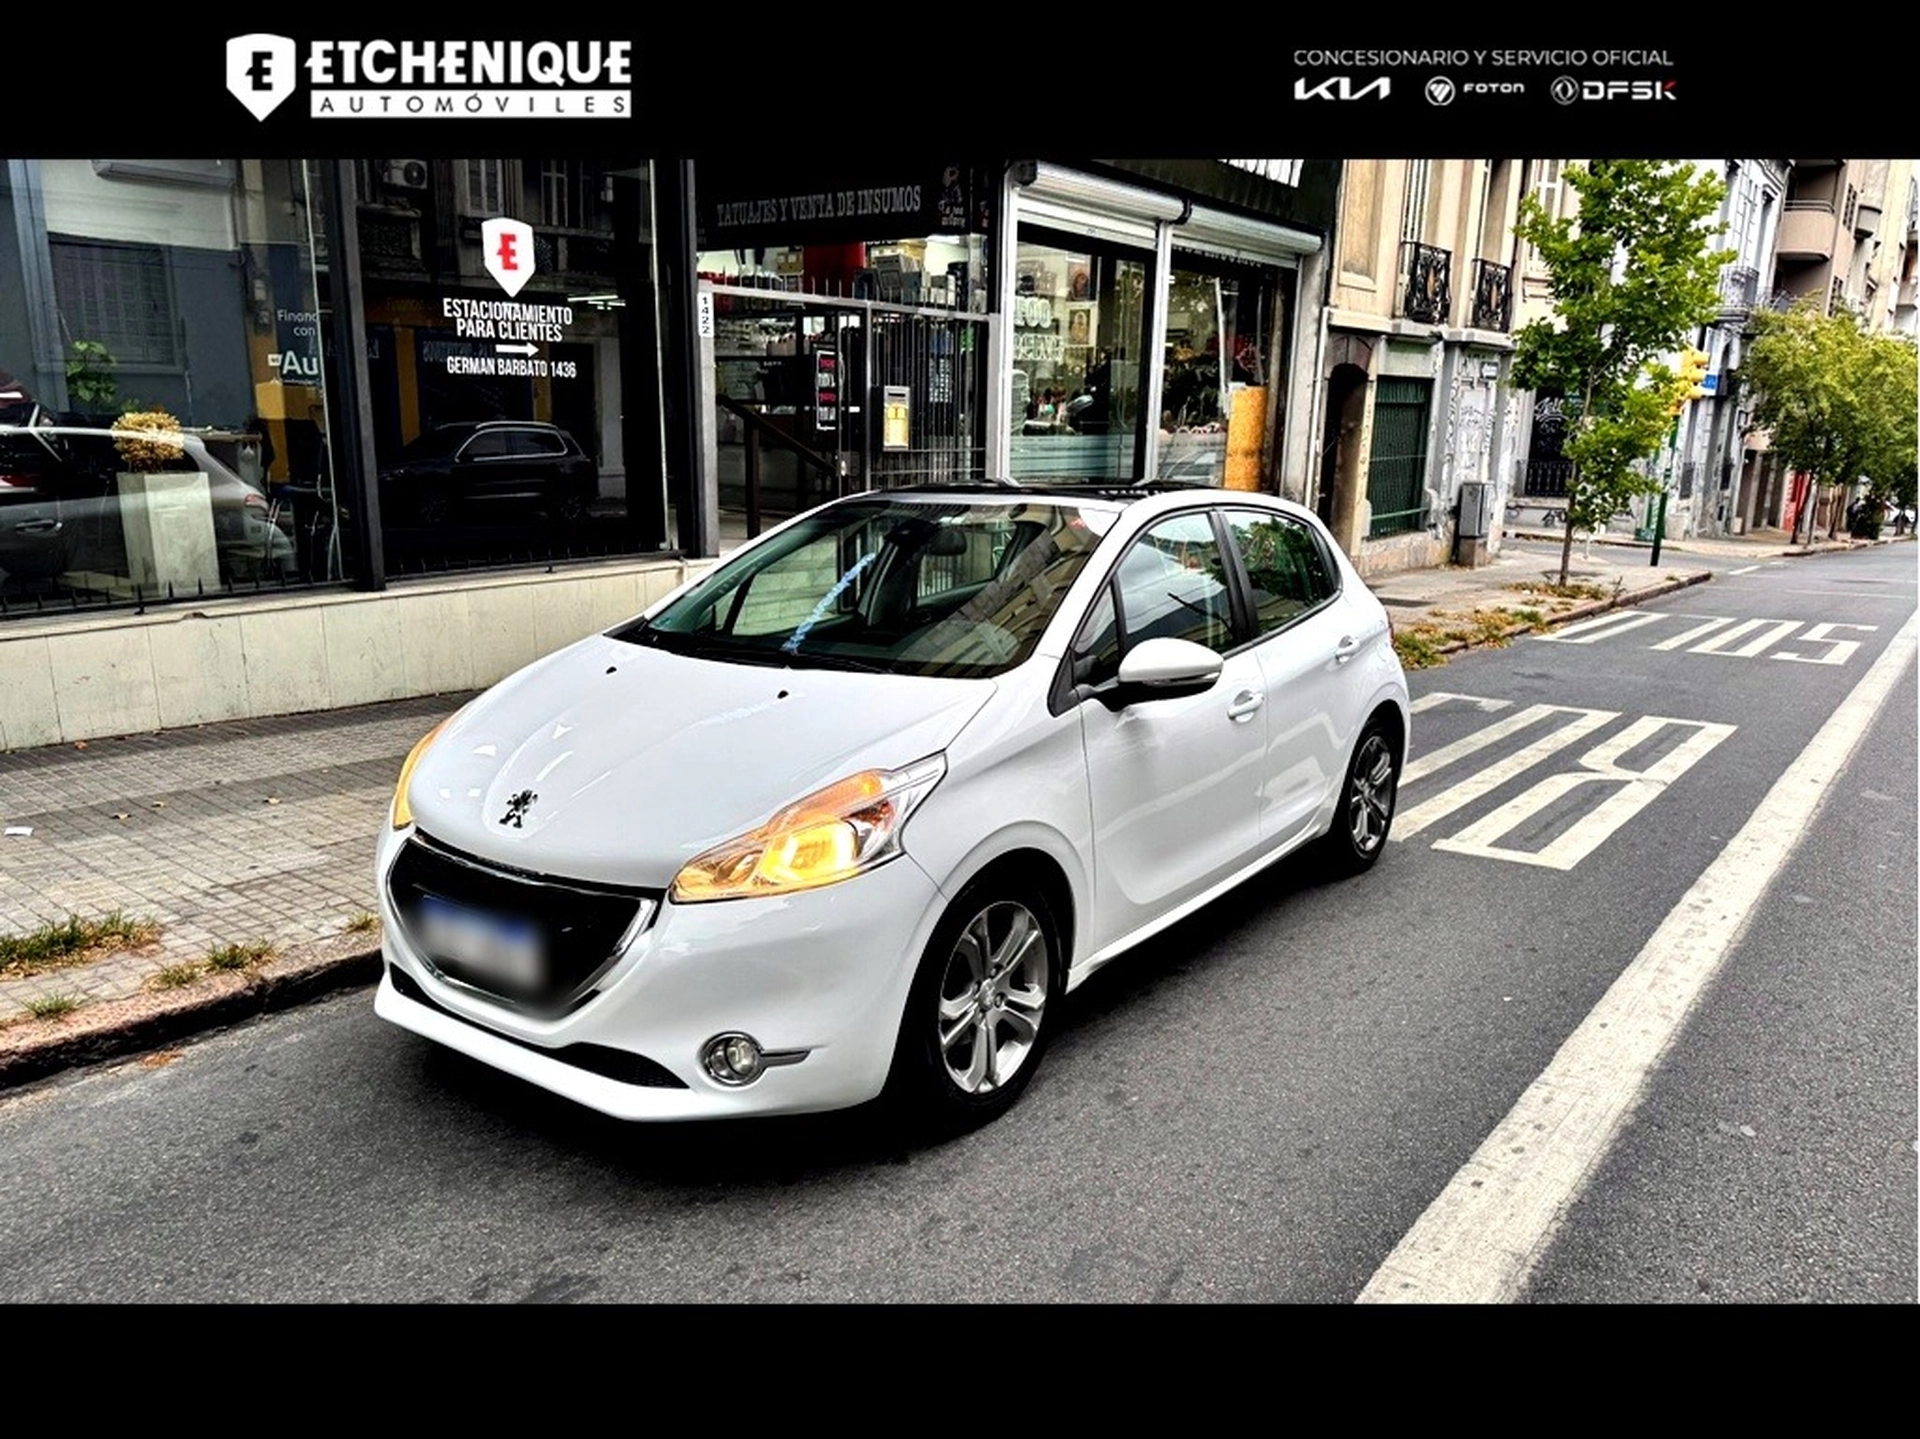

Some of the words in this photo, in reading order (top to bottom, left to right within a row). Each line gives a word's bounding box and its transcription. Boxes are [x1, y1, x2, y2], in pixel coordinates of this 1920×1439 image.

[716, 198, 778, 228] TATUAJES
[779, 197, 790, 222] Y
[790, 192, 834, 221] VENTA
[836, 190, 855, 218] DE
[856, 184, 922, 216] INSUMOS
[443, 297, 574, 326] ESTACIONAMIENTO
[700, 296, 711, 335] 1422
[292, 325, 317, 337] con
[456, 317, 496, 339] PARA
[498, 319, 564, 343] CLIENTES
[446, 355, 496, 376] GERMAN
[497, 358, 549, 378] BARBATO
[550, 360, 578, 379] 1436
